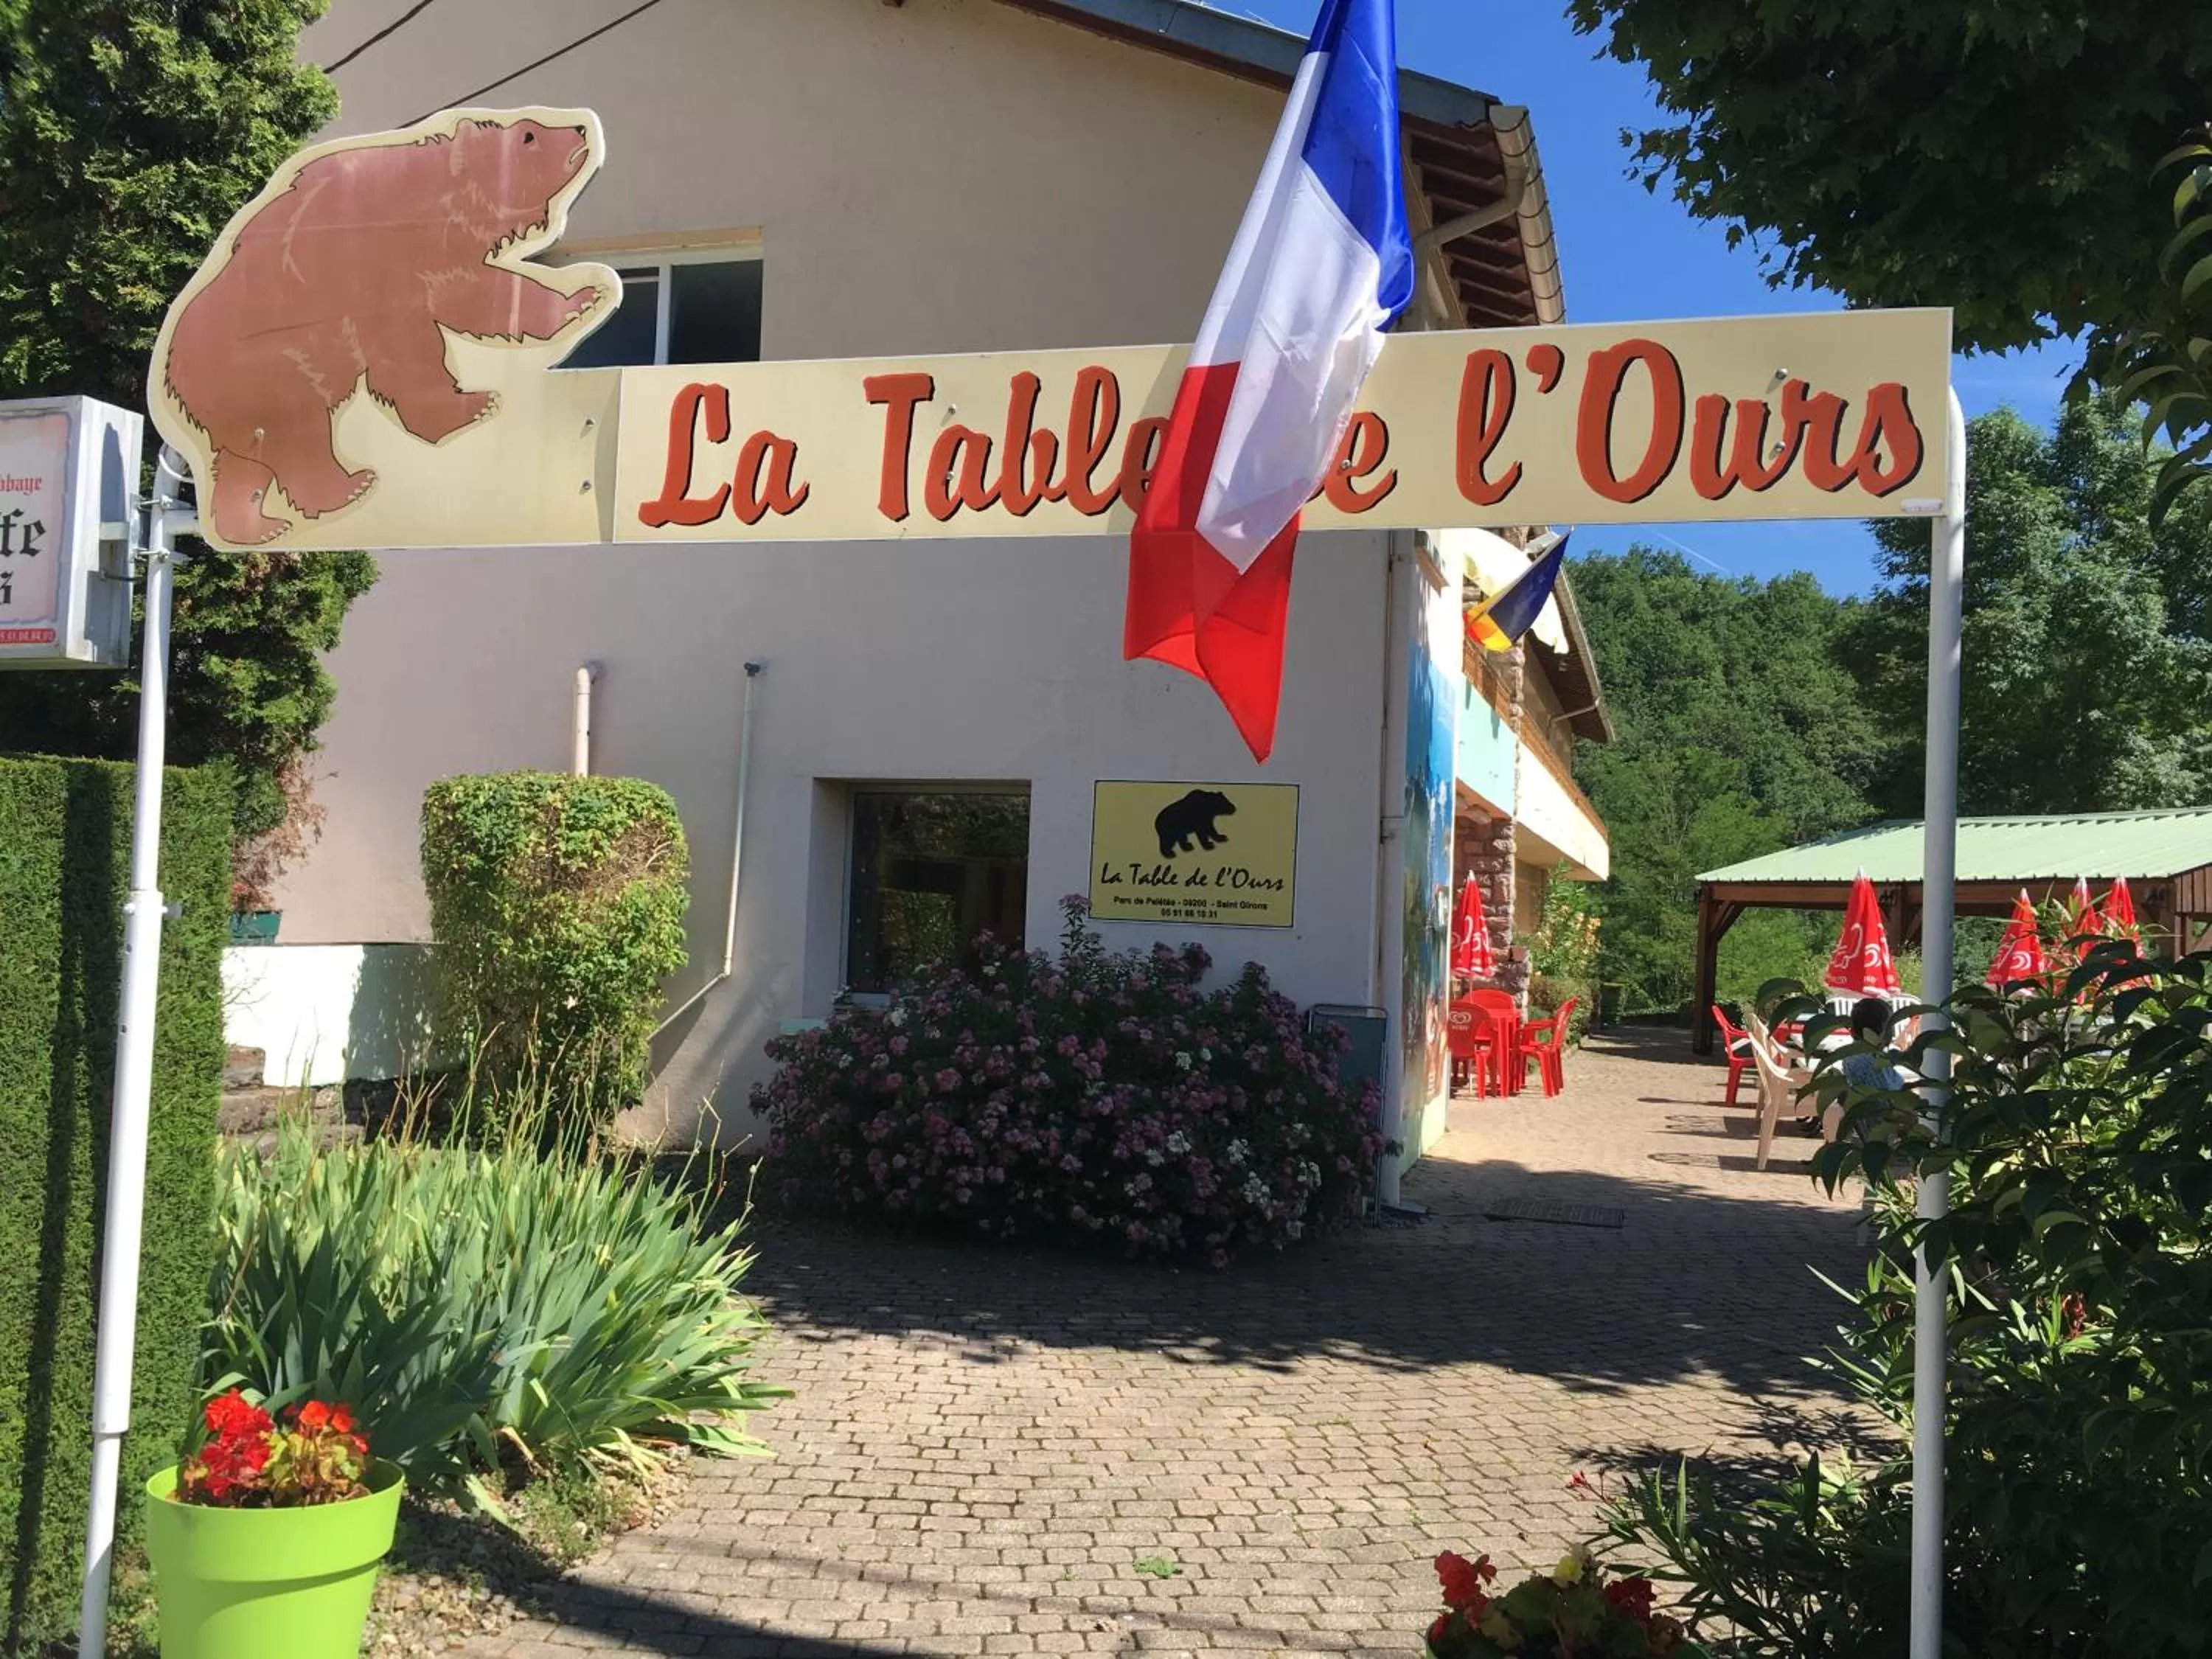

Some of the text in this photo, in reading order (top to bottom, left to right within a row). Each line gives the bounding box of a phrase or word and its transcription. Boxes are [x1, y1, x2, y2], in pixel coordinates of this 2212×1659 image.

[639, 338, 1924, 528] La Table e l'Ours
[0, 508, 46, 557] fe
[1101, 862, 1284, 891] La Table de l'Ours
[1113, 896, 1132, 905] Parc
[1133, 897, 1144, 905] de
[1216, 900, 1238, 908] Saint
[1239, 900, 1267, 910] Girons
